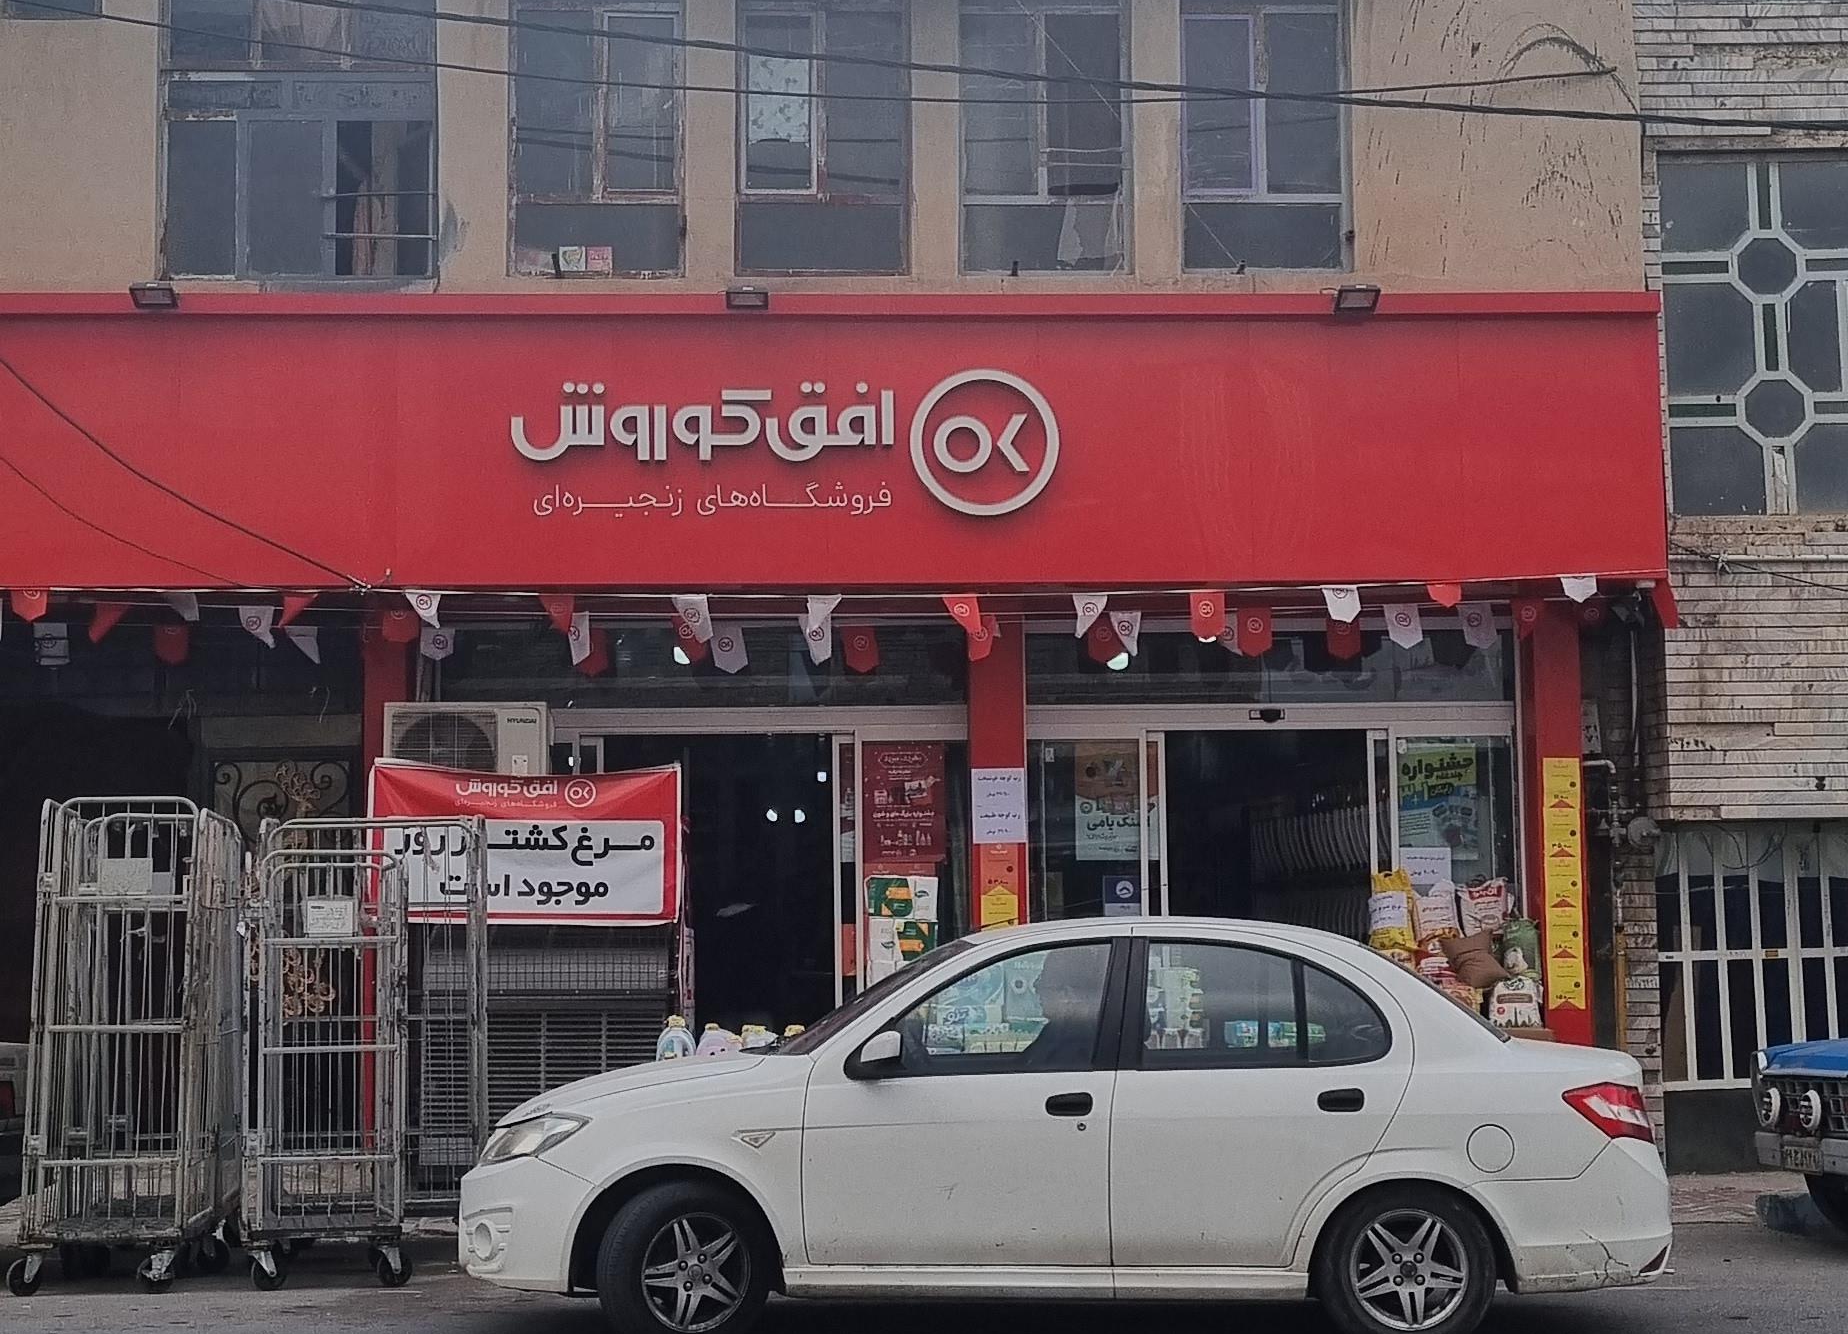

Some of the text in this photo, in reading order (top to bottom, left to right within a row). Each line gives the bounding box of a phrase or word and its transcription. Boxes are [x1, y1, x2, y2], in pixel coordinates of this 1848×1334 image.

[510, 381, 895, 463] افق کوروش
[450, 824, 568, 857] کشتر
[571, 826, 656, 867] مرغ
[517, 879, 609, 906] موجود
